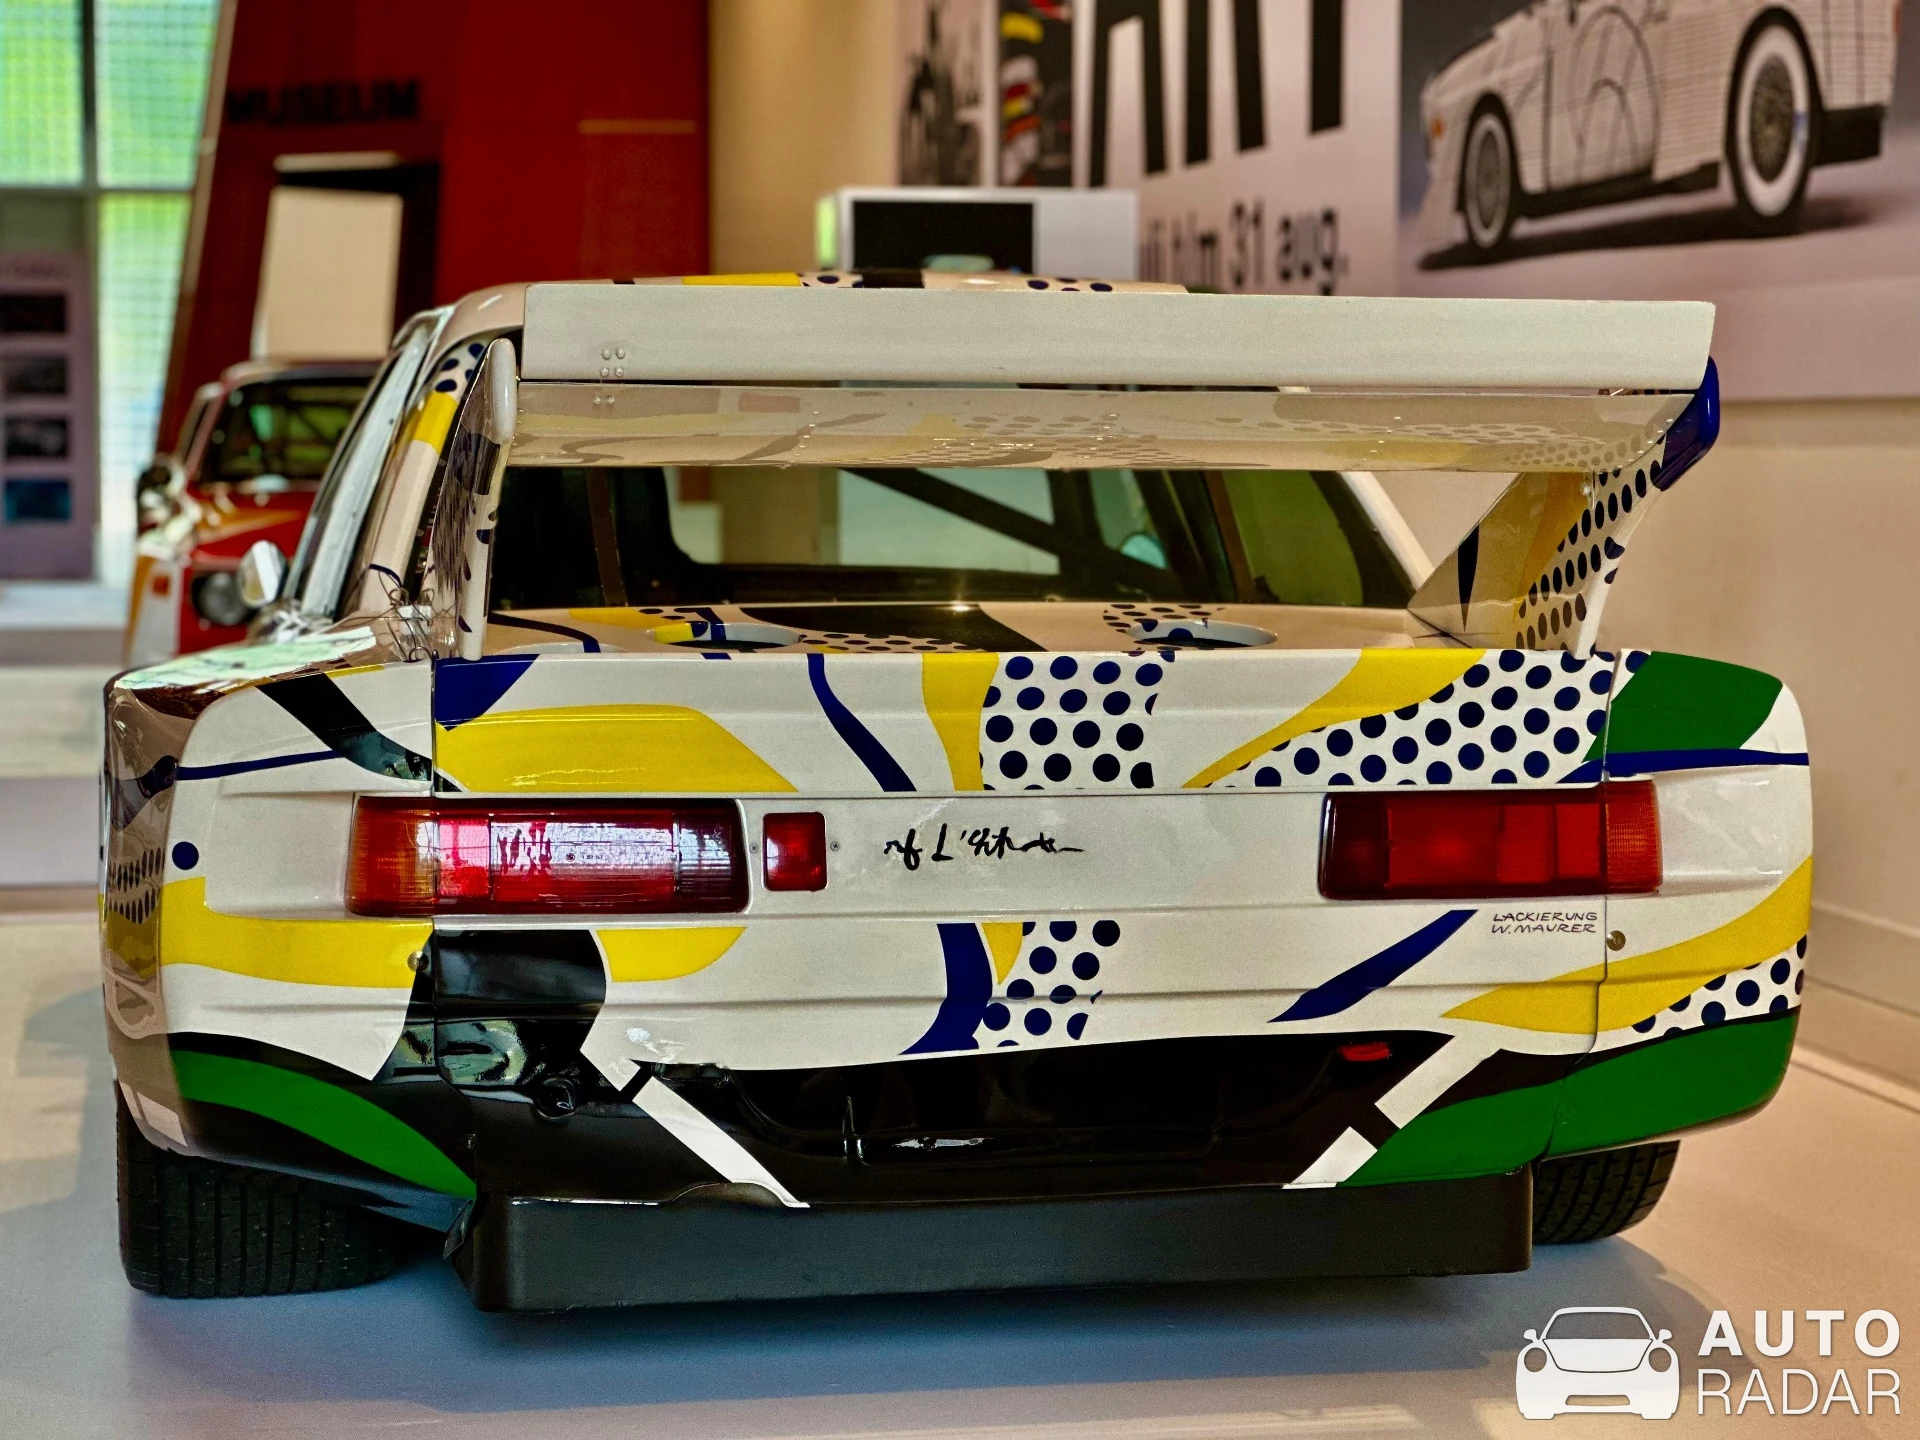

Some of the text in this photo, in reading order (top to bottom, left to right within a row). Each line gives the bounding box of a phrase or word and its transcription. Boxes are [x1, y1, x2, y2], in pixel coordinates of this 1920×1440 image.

[228, 80, 418, 127] MUSEUM
[1228, 198, 1265, 288] 31
[1493, 911, 1598, 922] LACKIERUNG
